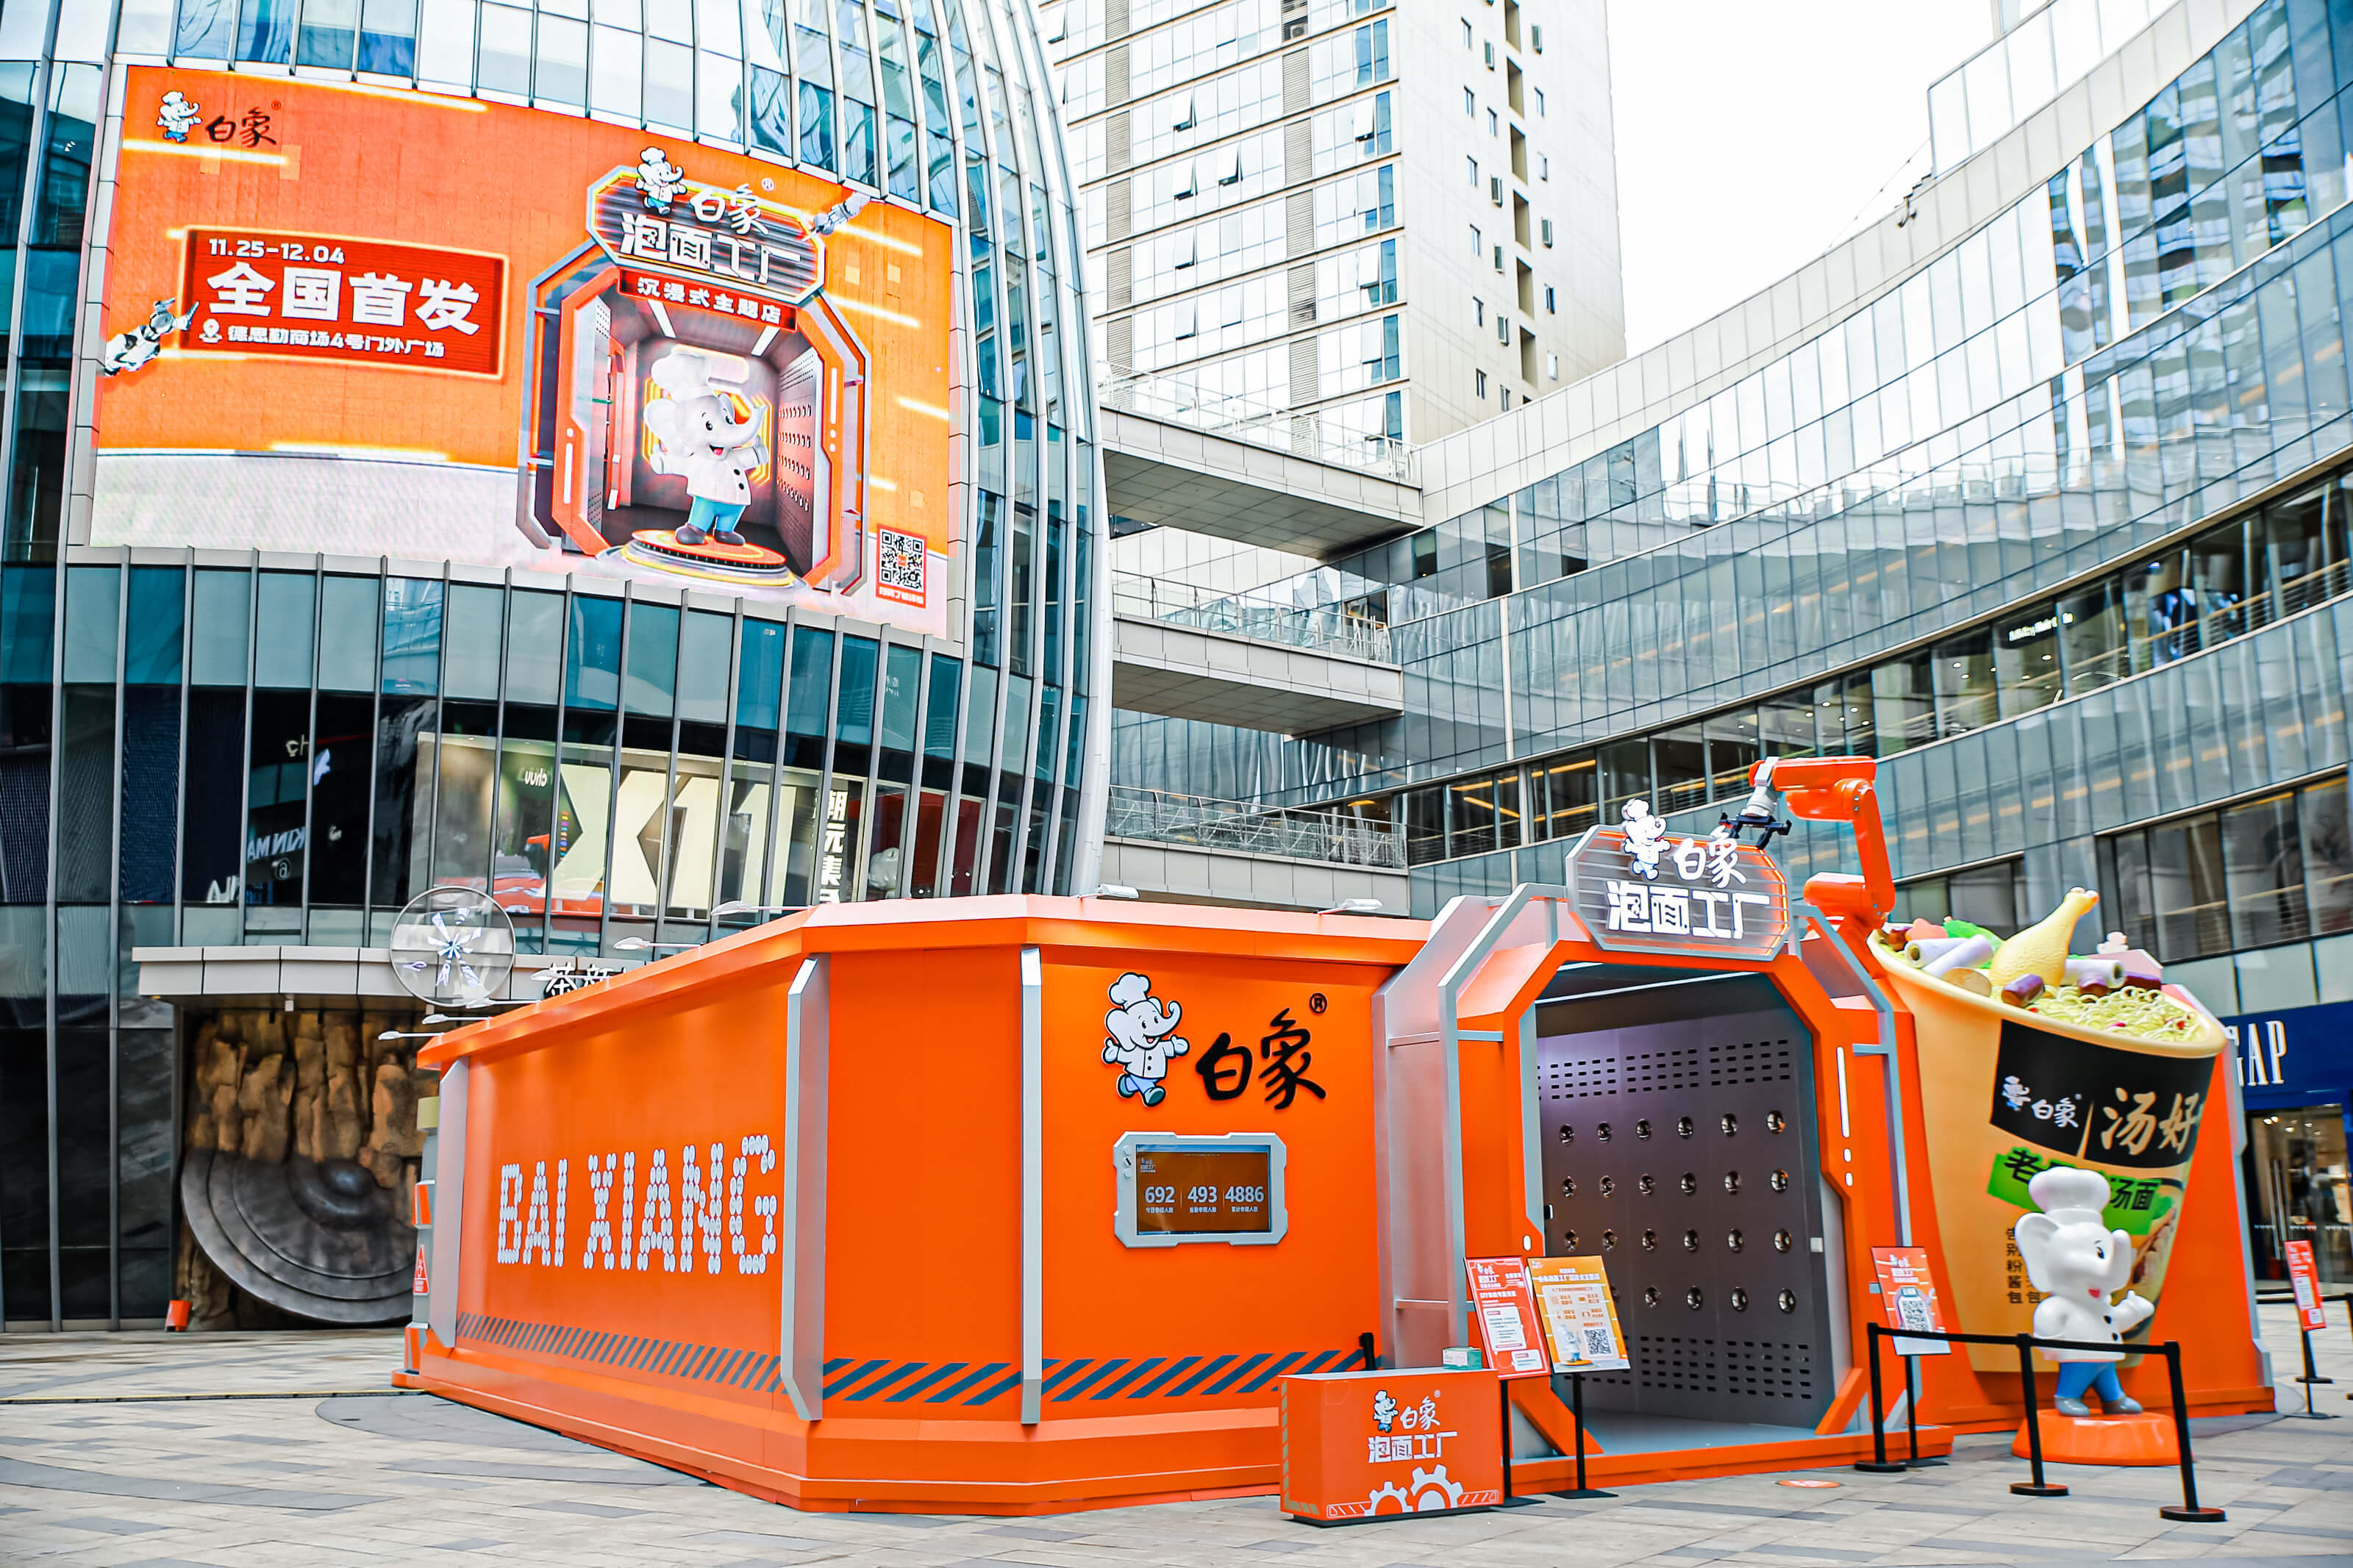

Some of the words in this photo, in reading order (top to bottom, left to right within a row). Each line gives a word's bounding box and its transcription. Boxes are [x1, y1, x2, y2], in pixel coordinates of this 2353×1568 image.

[205, 107, 277, 147] 白象
[690, 183, 769, 235] 白象
[209, 238, 345, 265] 11.25-12.04
[620, 212, 801, 284] 泡面工厂
[207, 262, 480, 335] 全国首发
[637, 276, 781, 325] 沉浸式主题店
[1673, 825, 1747, 889] 白象
[1607, 880, 1771, 940] 泡面工厂
[1196, 1008, 1327, 1110] 白象
[2031, 1097, 2079, 1128] 白象
[497, 1159, 568, 1267] BAI
[584, 1134, 776, 1275] XIANG
[1145, 1186, 1175, 1203] 692
[1188, 1186, 1218, 1203] 493
[1225, 1186, 1264, 1203] 4886
[1400, 1395, 1440, 1431] 白象
[1368, 1431, 1458, 1463] 泡面工厂
